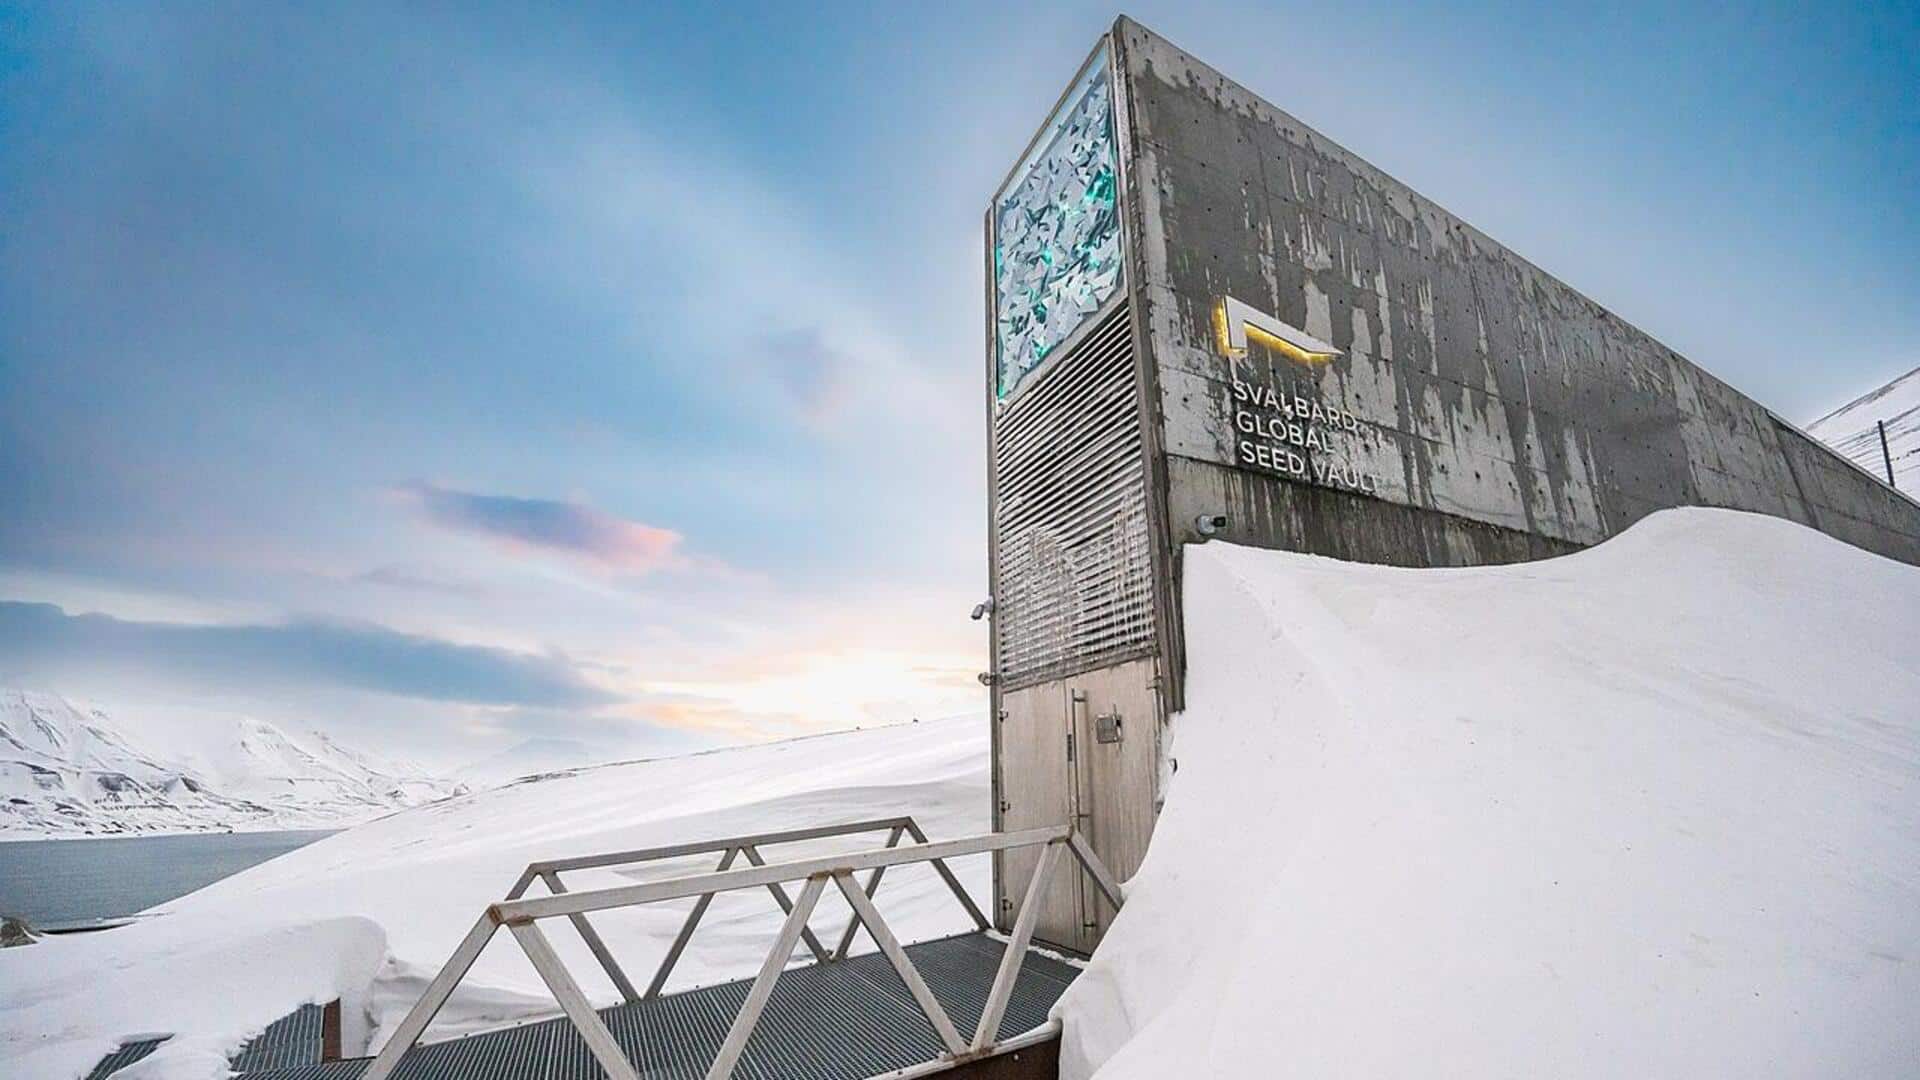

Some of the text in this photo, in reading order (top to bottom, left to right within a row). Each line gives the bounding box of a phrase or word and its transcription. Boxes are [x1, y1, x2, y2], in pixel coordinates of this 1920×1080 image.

[1232, 380, 1357, 430] SVALBARD
[1236, 411, 1335, 453] GLOBAL
[1240, 441, 1378, 492] SEED VAULT
